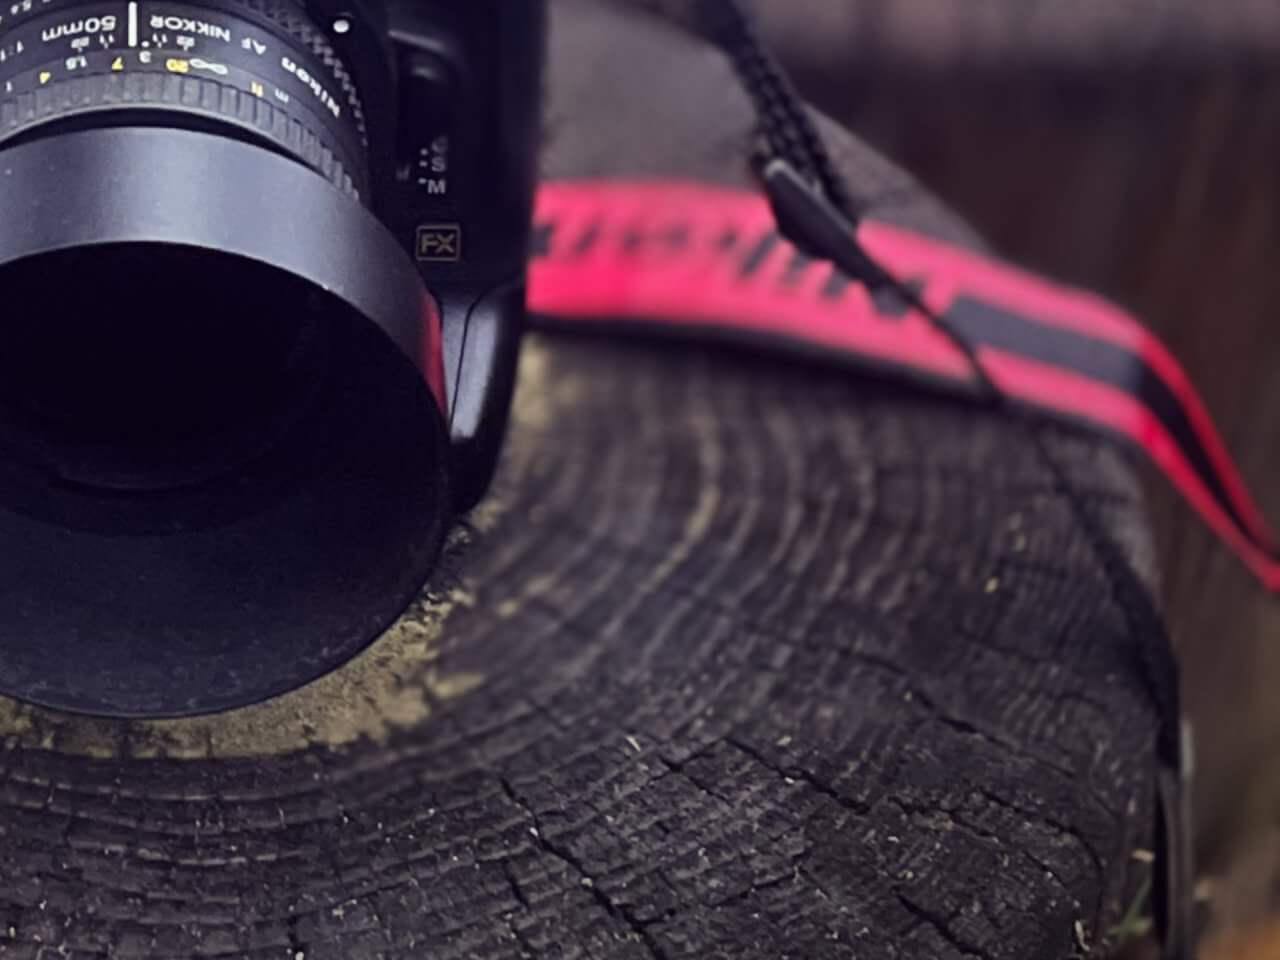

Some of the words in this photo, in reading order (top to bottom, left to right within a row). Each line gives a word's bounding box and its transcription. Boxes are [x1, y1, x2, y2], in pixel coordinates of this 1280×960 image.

[41, 15, 116, 43] 50mm
[150, 14, 231, 43] NIKKOR
[281, 57, 341, 118] Nikon
[427, 179, 446, 194] M
[421, 233, 455, 253] FX
